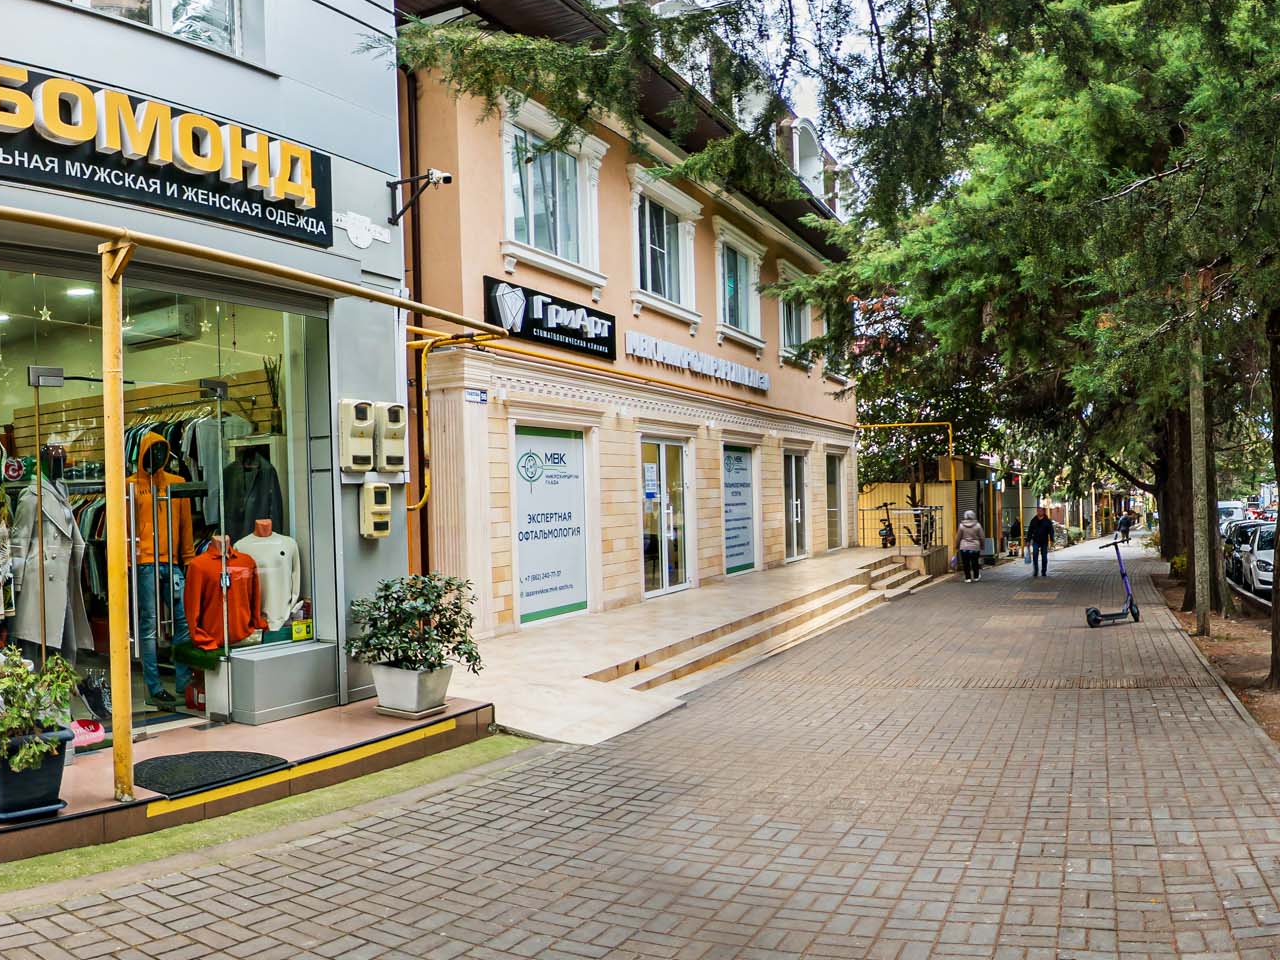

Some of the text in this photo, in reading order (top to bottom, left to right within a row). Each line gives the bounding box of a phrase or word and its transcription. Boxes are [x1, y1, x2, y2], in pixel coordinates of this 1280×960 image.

[65, 160, 161, 195] МУЖСКАЯ
[166, 181, 178, 199] И
[182, 185, 262, 218] ЖЕНСКАЯ
[265, 207, 327, 235] ОДЕЖДА
[544, 452, 567, 465] МВК
[527, 511, 572, 524] ЭКСПЕРТНАЯ
[518, 526, 581, 542] ОФТАЛЬМОЛОГИЯ
